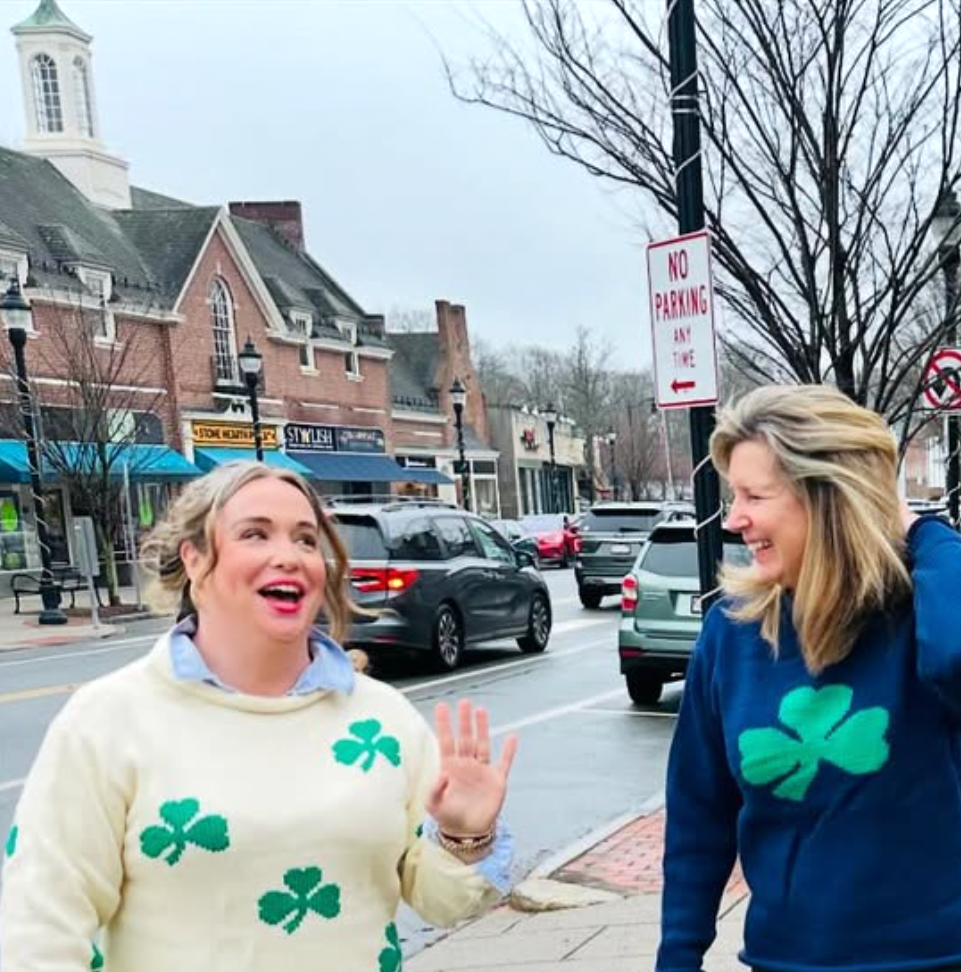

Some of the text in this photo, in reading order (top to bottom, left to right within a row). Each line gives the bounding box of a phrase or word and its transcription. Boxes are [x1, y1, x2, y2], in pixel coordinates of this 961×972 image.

[668, 249, 688, 282] NO
[655, 285, 707, 321] PARKING
[674, 327, 691, 344] ANY
[672, 349, 696, 368] TIME
